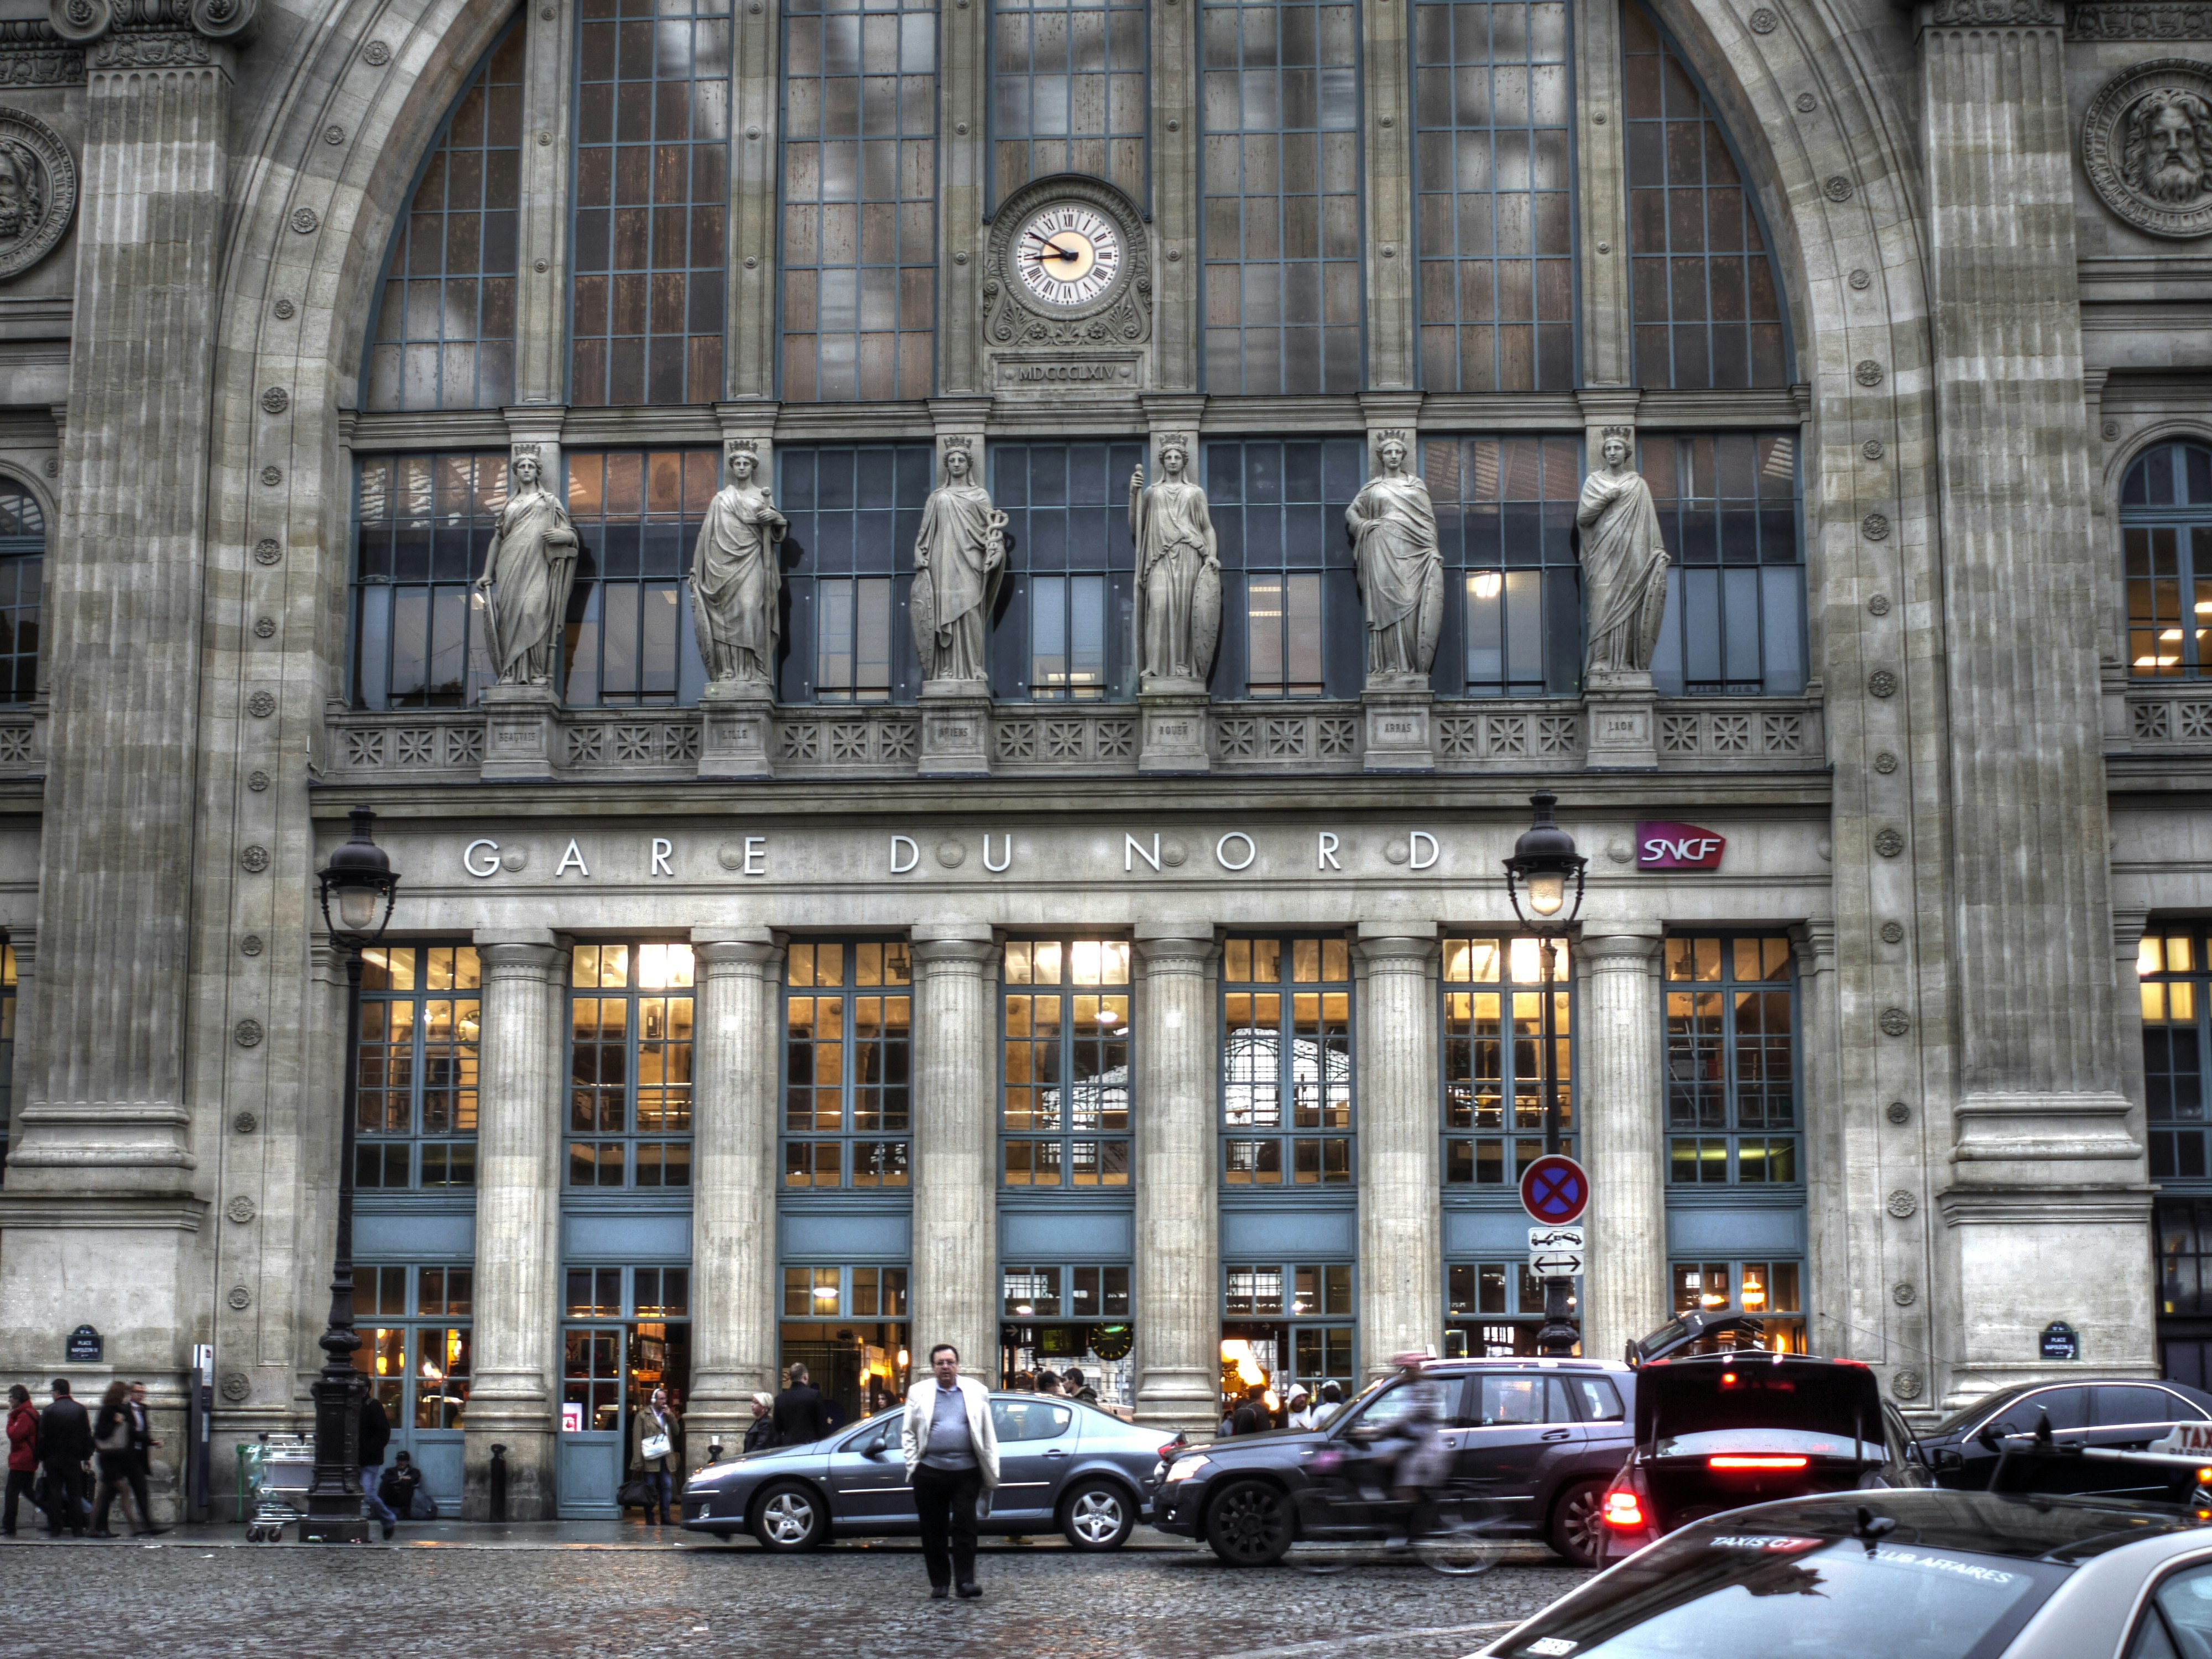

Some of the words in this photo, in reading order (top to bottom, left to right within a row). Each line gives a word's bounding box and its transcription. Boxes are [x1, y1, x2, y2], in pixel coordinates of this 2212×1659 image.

[1043, 218, 1056, 232] XI
[1063, 214, 1073, 227] XII
[1094, 232, 1107, 243] II
[1042, 280, 1055, 295] VII
[1063, 285, 1072, 299] VI
[1019, 366, 1116, 381] MDCCCLXIV
[1384, 723, 1412, 733] ARRAS
[463, 836, 766, 878] GARE
[890, 833, 1013, 874] DU
[1125, 830, 1439, 872] NORD
[1641, 838, 1721, 861] SNCF
[1710, 1537, 1769, 1547] TAXIS
[1768, 1539, 1802, 1548] G7
[1865, 1548, 1917, 1563] CLUB
[1914, 1557, 2015, 1583] AFFAIRES
